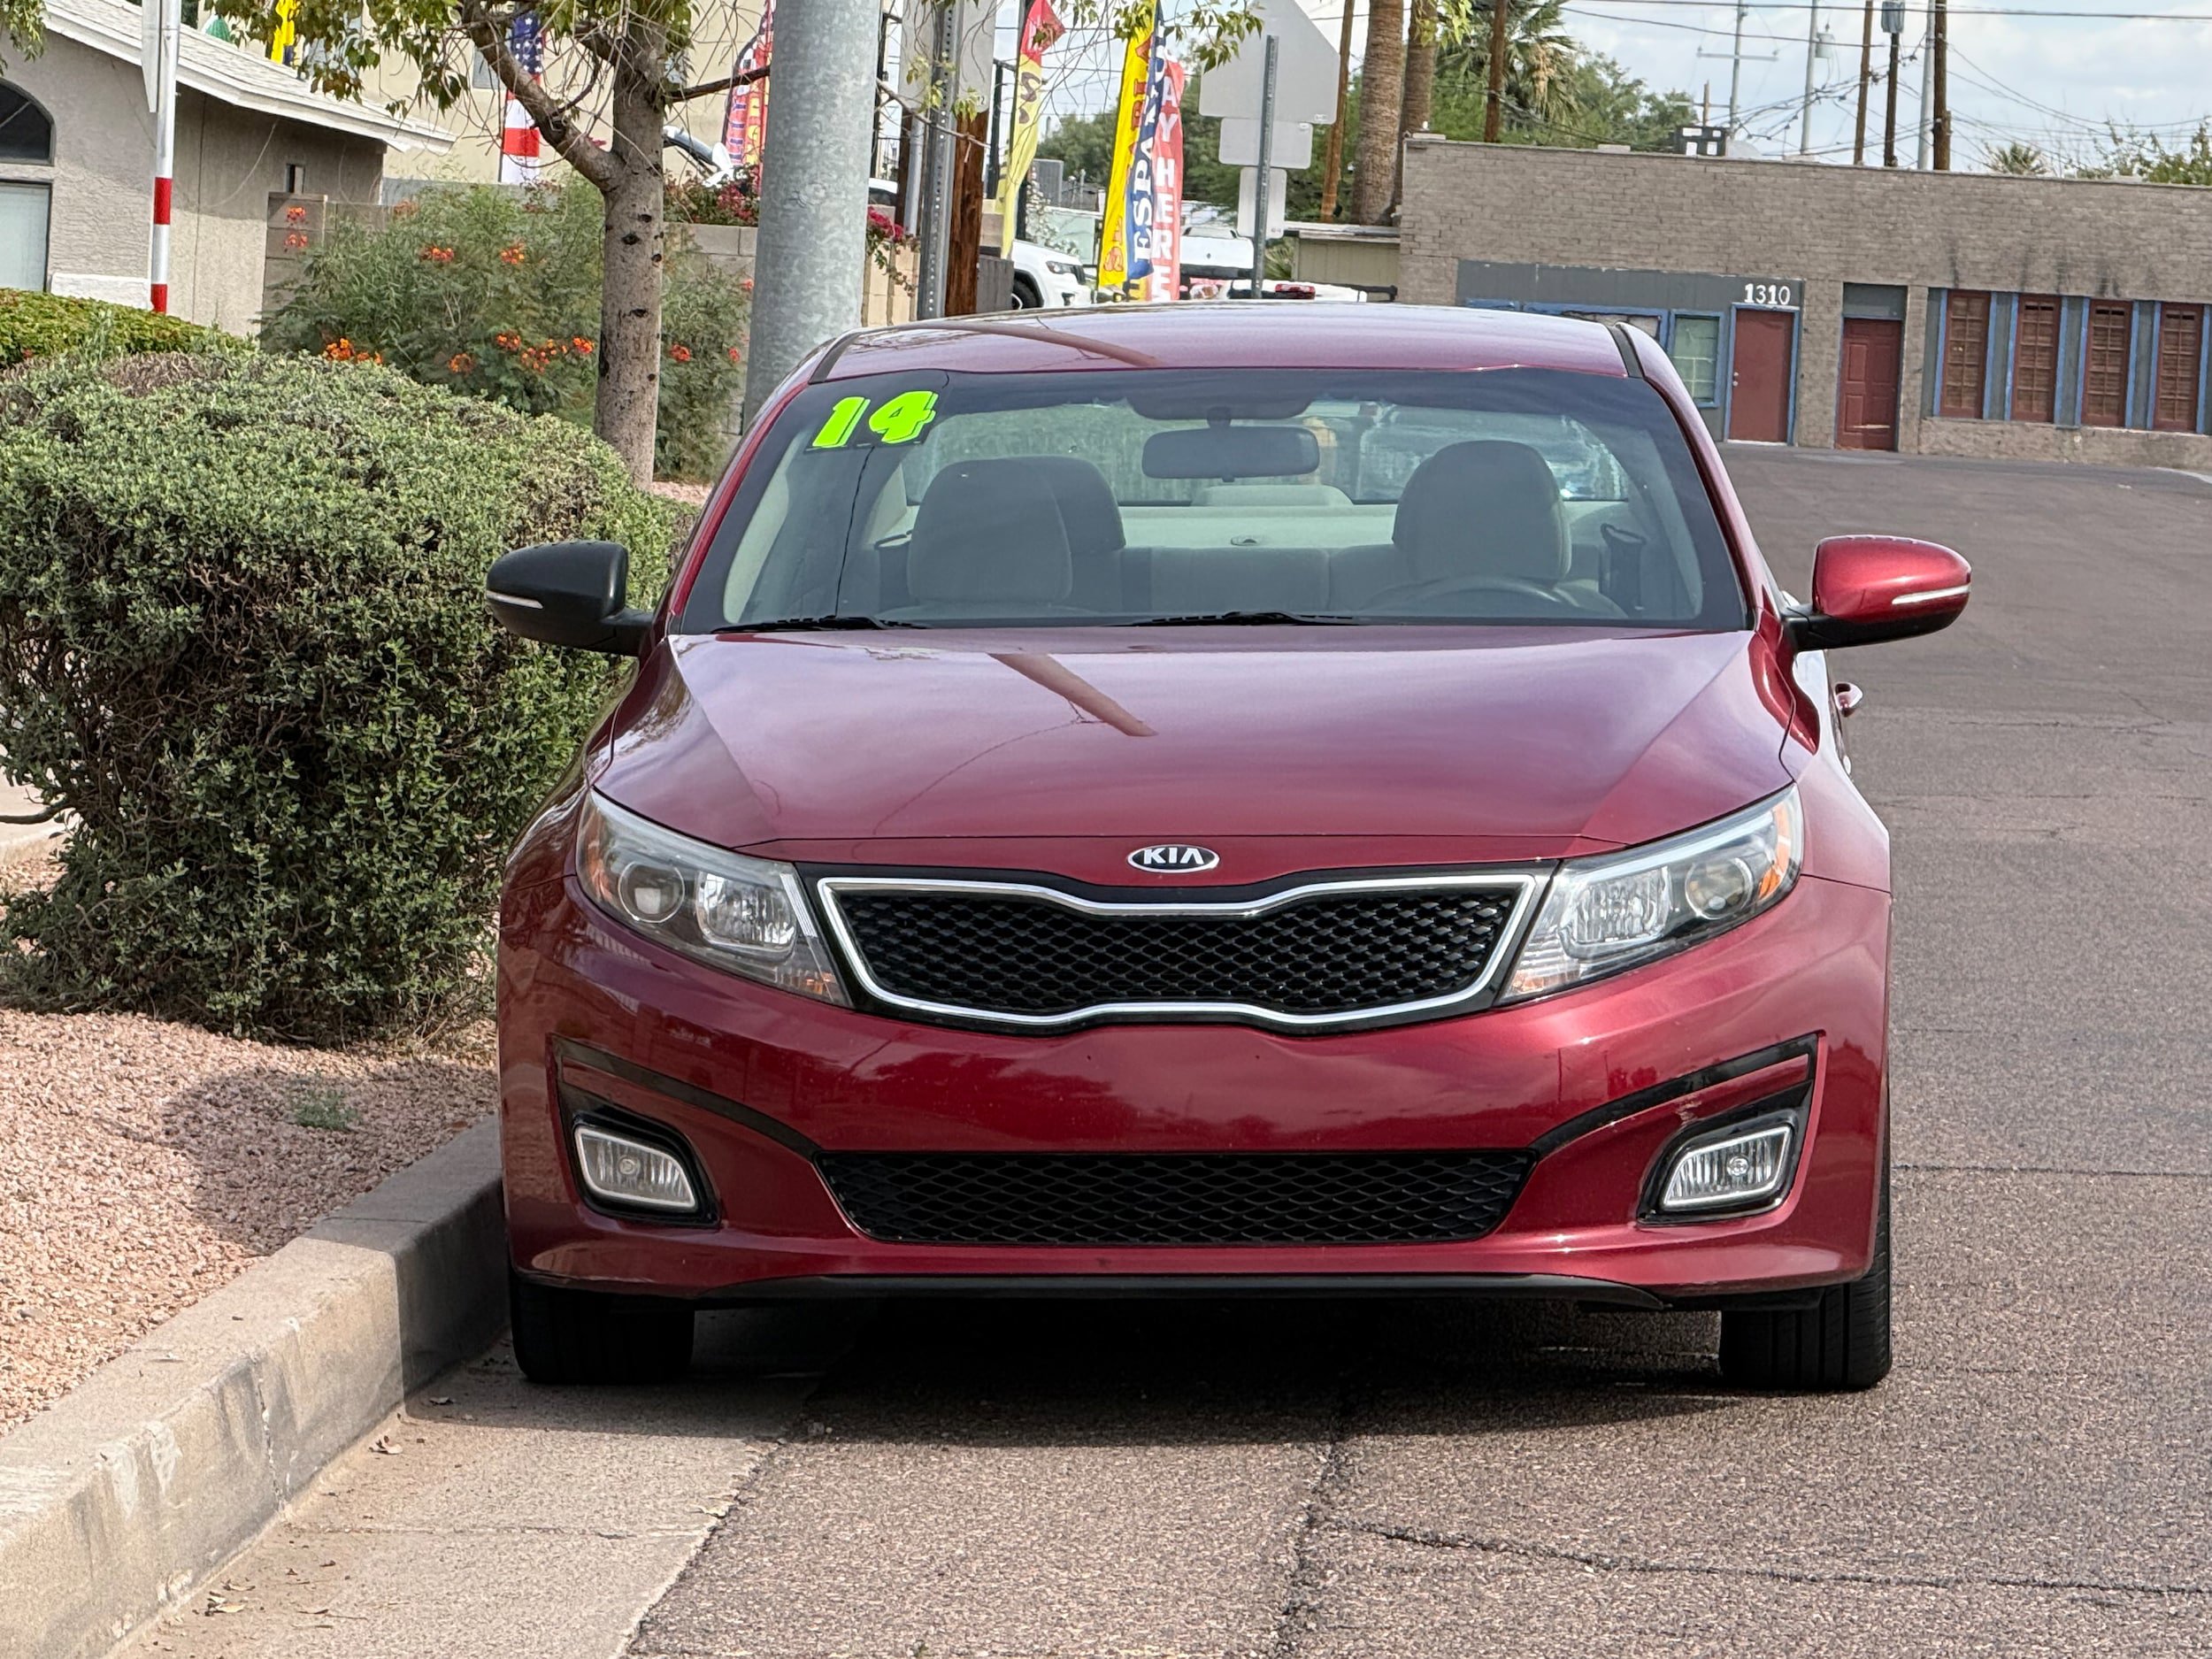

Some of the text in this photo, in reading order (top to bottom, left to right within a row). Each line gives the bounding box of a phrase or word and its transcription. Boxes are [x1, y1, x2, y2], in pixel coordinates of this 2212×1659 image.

[1150, 156, 1175, 301] HERE
[1744, 283, 1791, 305] 1310
[812, 390, 939, 449] 14
[1143, 847, 1204, 864] KIA
